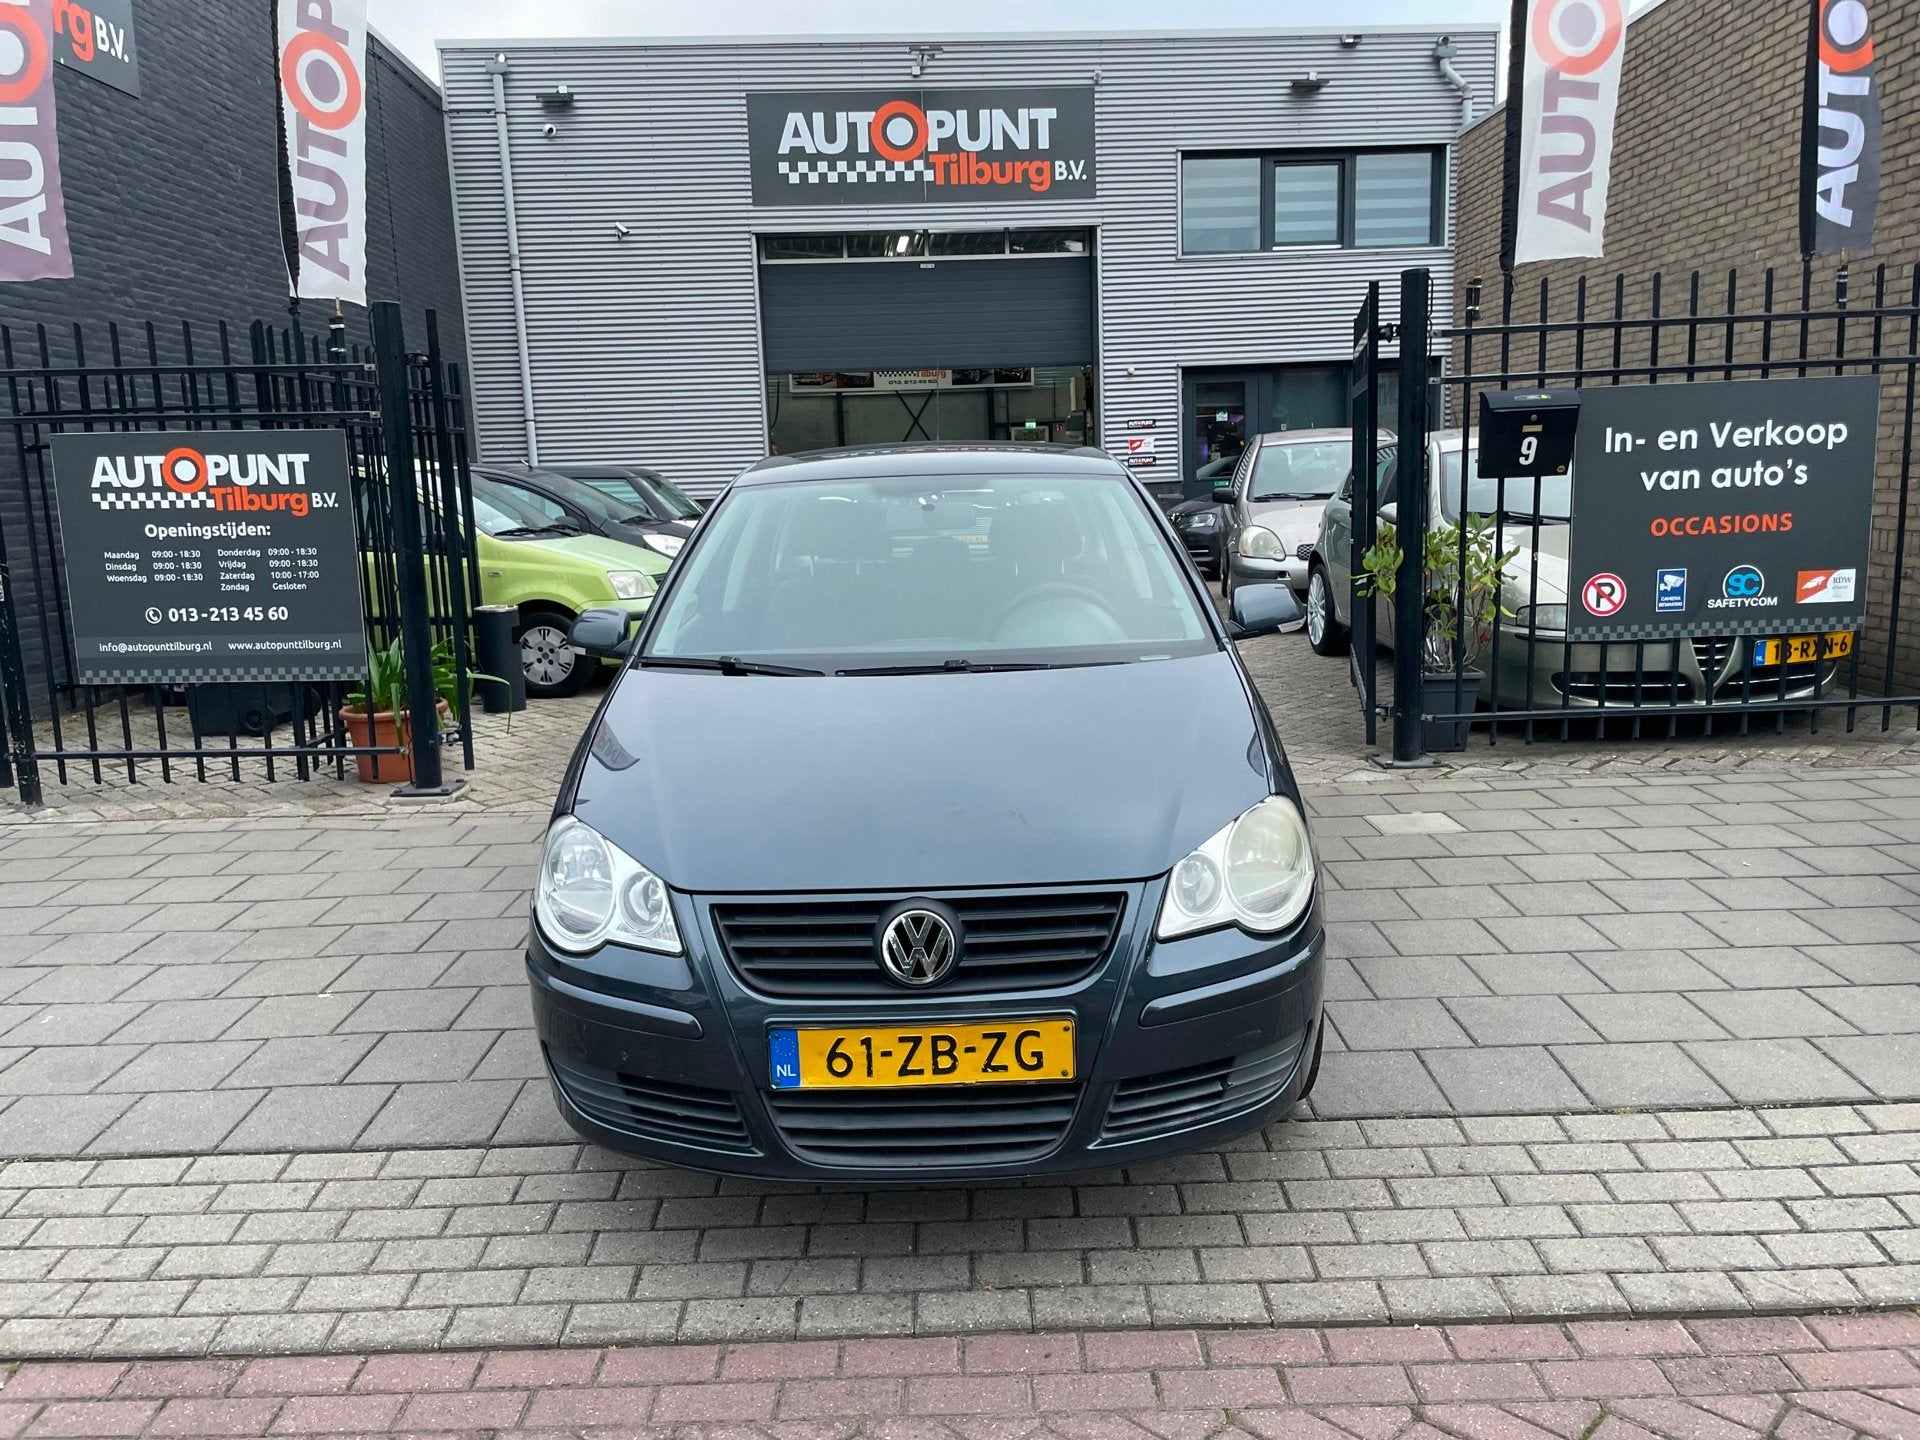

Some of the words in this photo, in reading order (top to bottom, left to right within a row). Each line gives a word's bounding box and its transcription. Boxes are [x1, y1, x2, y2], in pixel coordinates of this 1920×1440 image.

[95, 15, 129, 63] B.V.
[778, 99, 1057, 162] AUTOPUNT
[928, 152, 1051, 192] Tilburg
[1054, 160, 1087, 181] B.V.
[1605, 427, 1646, 453] In-
[1657, 427, 1698, 452] en
[1709, 419, 1849, 450] Verkoop
[1519, 436, 1538, 466] 9
[91, 447, 309, 493] AUTOPUNT
[1640, 467, 1700, 491] van
[1711, 458, 1809, 489] auto's
[210, 487, 308, 516] Tilburg
[312, 493, 338, 508] B.V.
[145, 522, 271, 539] Openingstijden:
[1650, 512, 1793, 538] OCCASIONS
[104, 551, 140, 560] Maandag
[179, 550, 201, 558] 18:30
[217, 548, 261, 557] Donderdag
[295, 547, 317, 555] 18:30
[105, 562, 137, 571] Dinsdag
[153, 562, 175, 570] 09:00
[181, 561, 202, 570] 18:30
[218, 560, 247, 569] Vrijdag
[297, 559, 318, 567] 18:30
[106, 574, 147, 583] Woensdag
[154, 573, 176, 581] 09:00
[182, 573, 203, 581] 18:30
[220, 572, 255, 581] Zaterdag
[270, 571, 292, 579] 10:00
[298, 571, 320, 579] 17:00
[220, 583, 250, 592] Zondag
[272, 582, 307, 590] Gesloten
[1707, 596, 1778, 608] SAFETYCOM
[243, 606, 264, 621] 45
[268, 606, 289, 621] 60
[99, 641, 213, 652] info@autopunttilburg.nl
[228, 639, 342, 650] www.autopunttilburg.nl
[826, 1029, 1044, 1078] 61-ZB-ZG
[776, 1063, 796, 1077] NL
